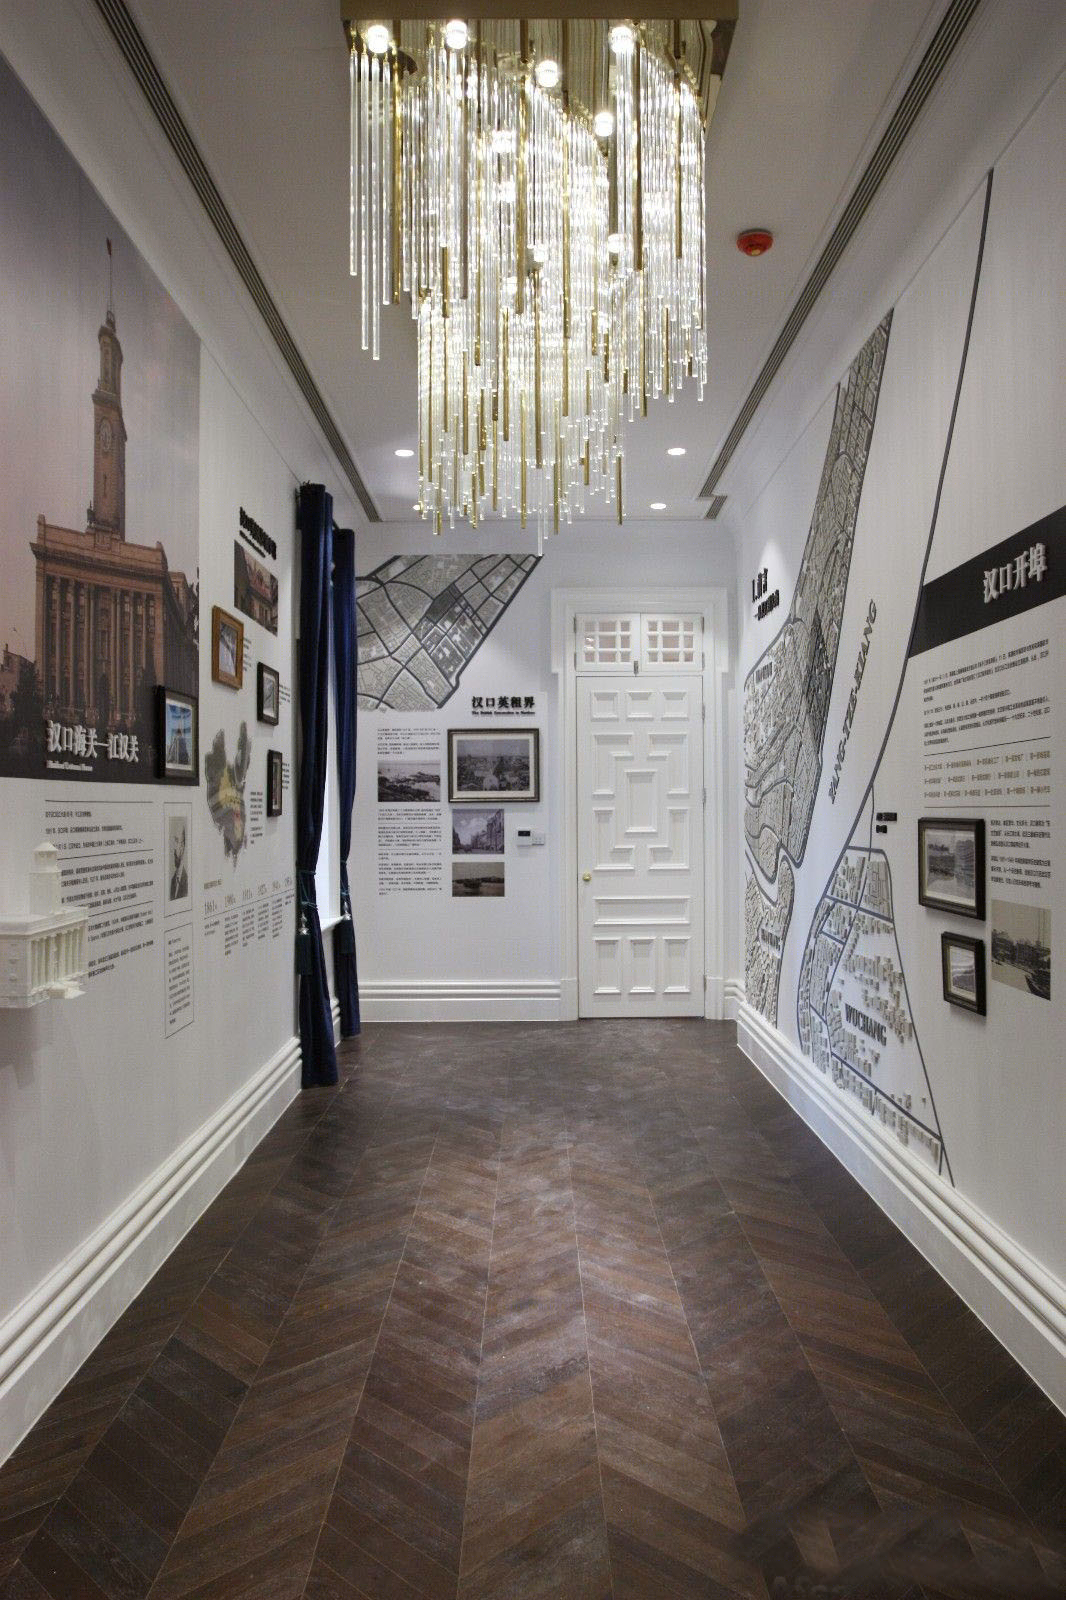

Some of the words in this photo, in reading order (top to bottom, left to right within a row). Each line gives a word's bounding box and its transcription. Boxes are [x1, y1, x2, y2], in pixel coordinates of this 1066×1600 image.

[983, 542, 1048, 604] 汉口开埠
[472, 696, 535, 708] 汉口英租界
[845, 1003, 887, 1047] WUCHANG
